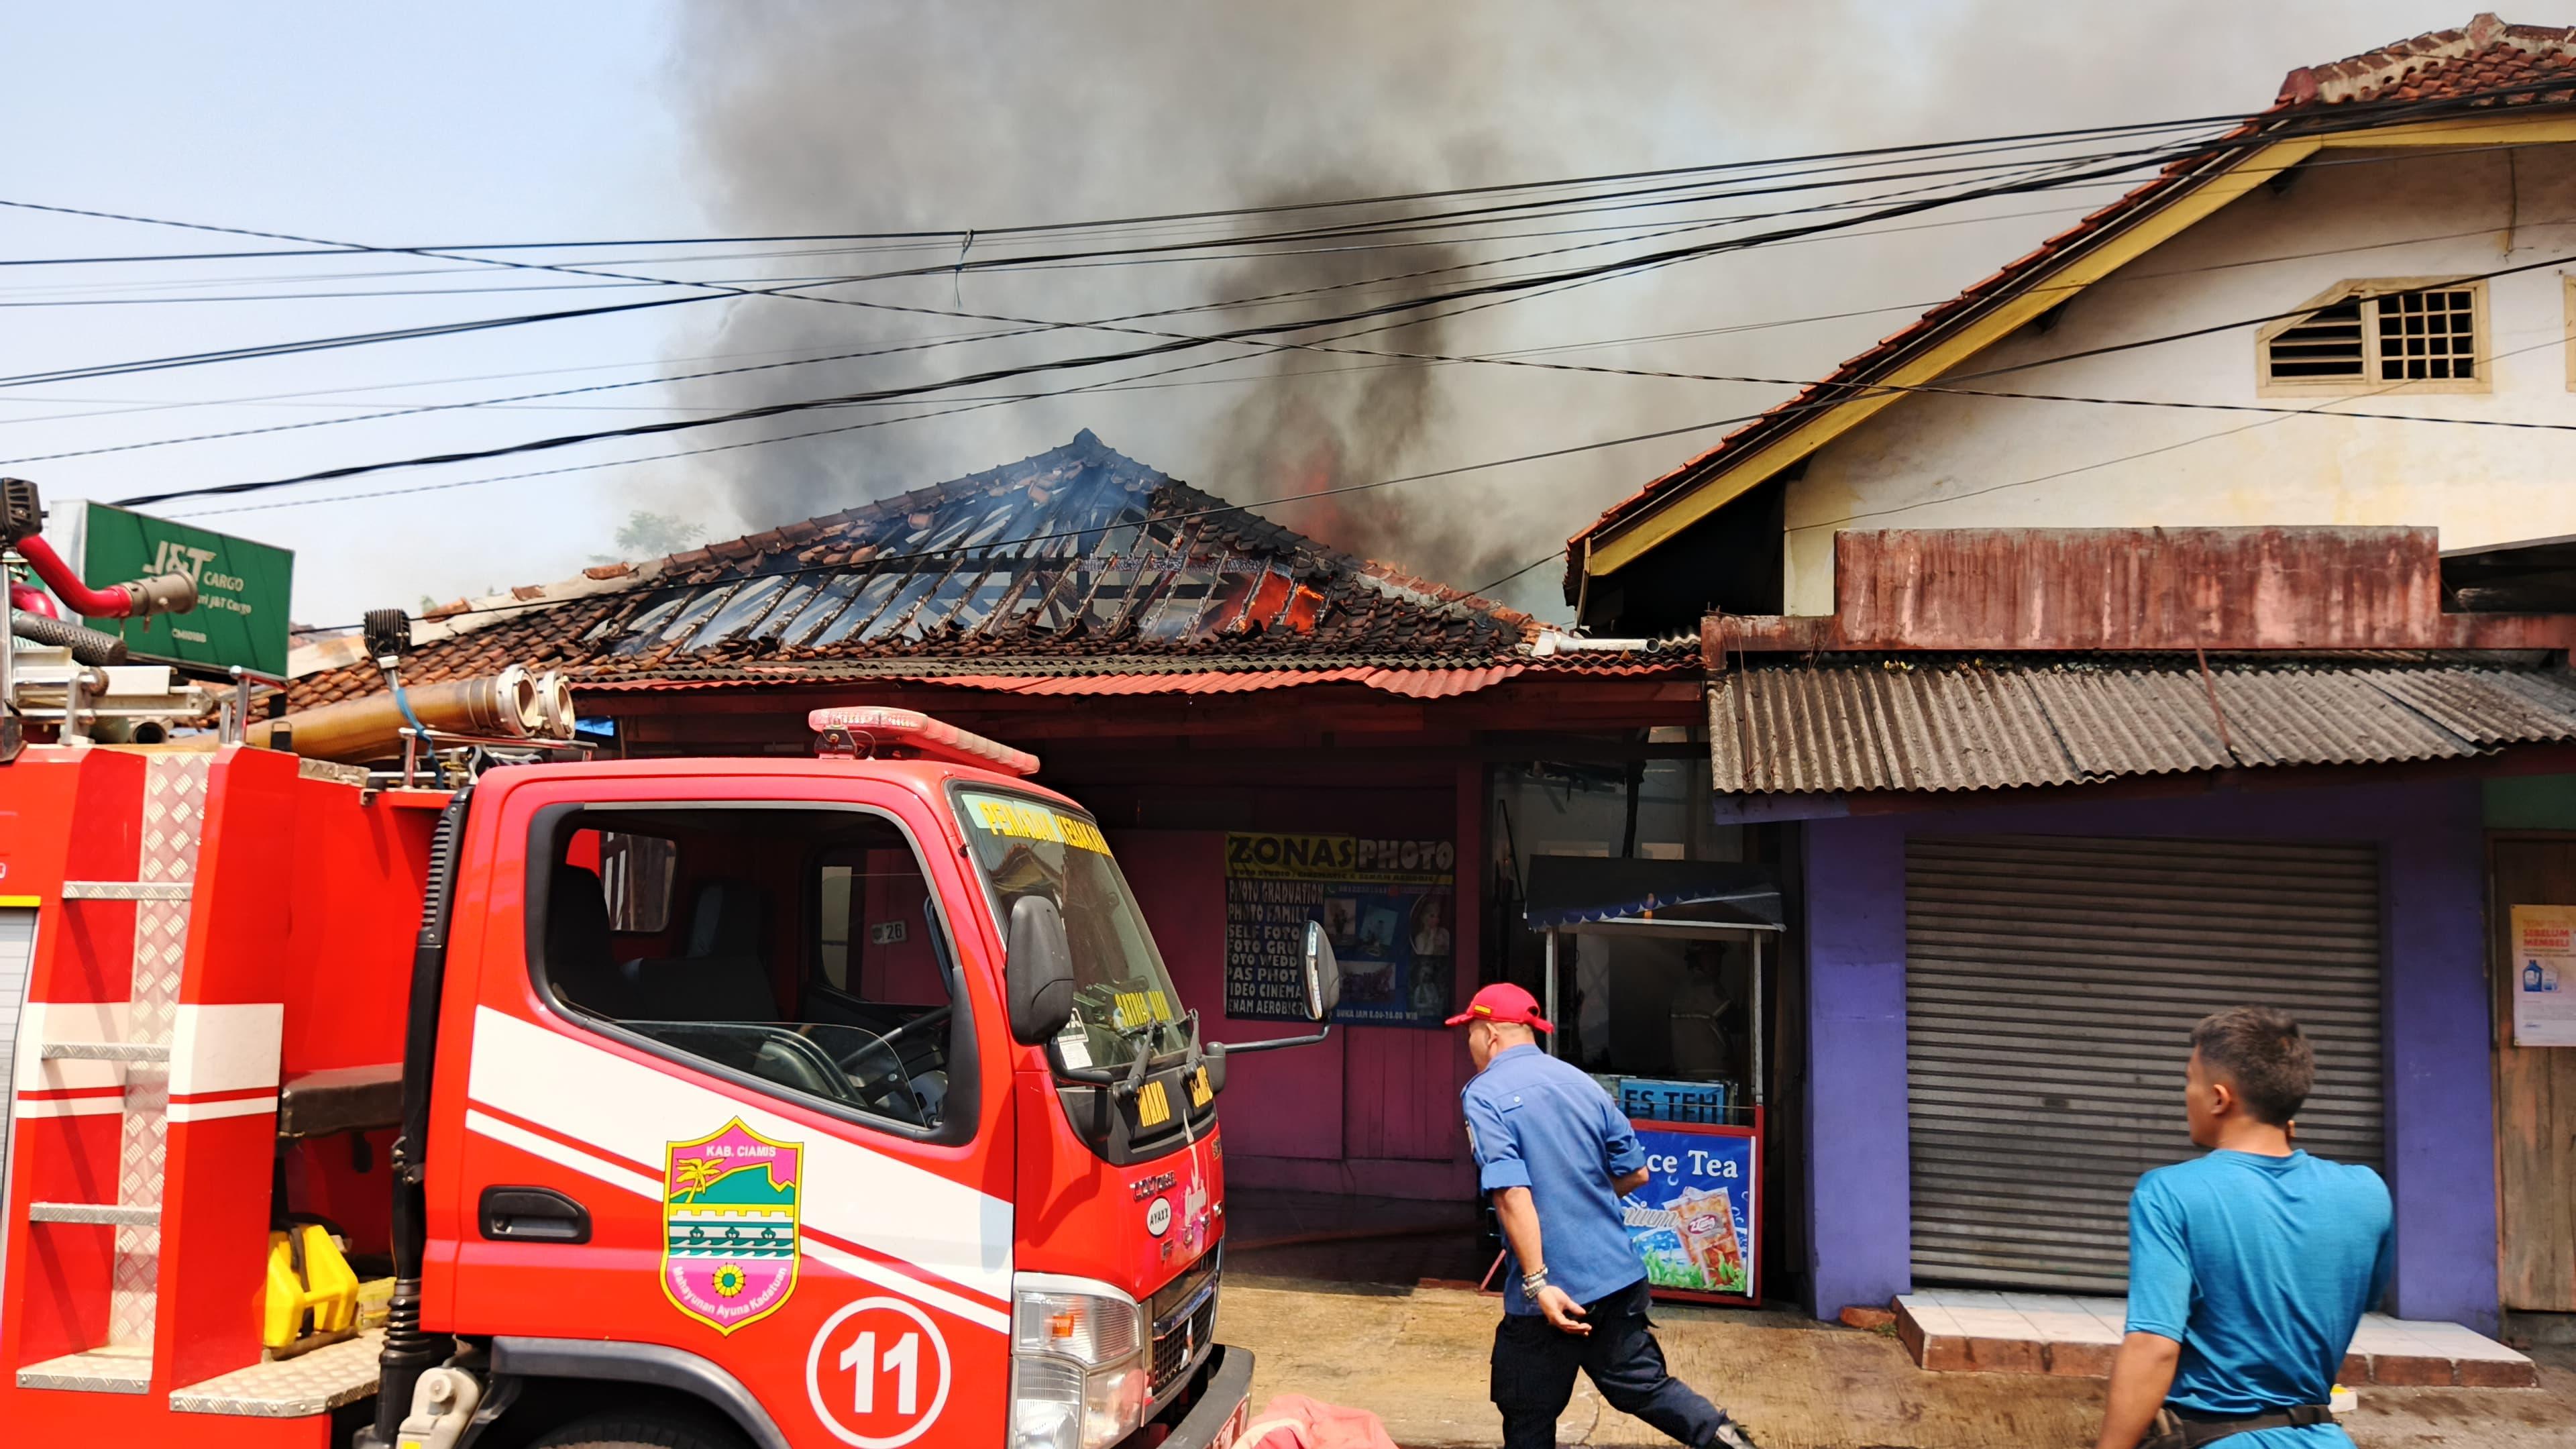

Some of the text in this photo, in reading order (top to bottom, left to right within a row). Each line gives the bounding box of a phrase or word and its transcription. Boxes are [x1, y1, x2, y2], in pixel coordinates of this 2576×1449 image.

[142, 540, 244, 592] J&T CARGO
[227, 600, 252, 615] Cargo
[1229, 837, 1454, 870] ZONAS PHOTO
[1262, 881, 1324, 904] GRADUATION
[1267, 904, 1309, 923] FAMILY
[885, 924, 902, 939] 26
[1228, 925, 1299, 940] SELF FOTO
[1267, 941, 1297, 955] GRU
[1259, 955, 1298, 967] WEDD
[1257, 968, 1298, 983] PHOT
[1230, 983, 1301, 998] IDEO CINEMA
[1228, 999, 1254, 1013] ENAM
[1625, 1089, 1717, 1118] ES TEH
[706, 1146, 776, 1158] KAB. CIAMIS
[1641, 1148, 1738, 1178] ce Tea
[672, 1266, 715, 1314] Mahayunan
[749, 1267, 787, 1311] Kadatuan
[839, 1331, 918, 1414] 11
